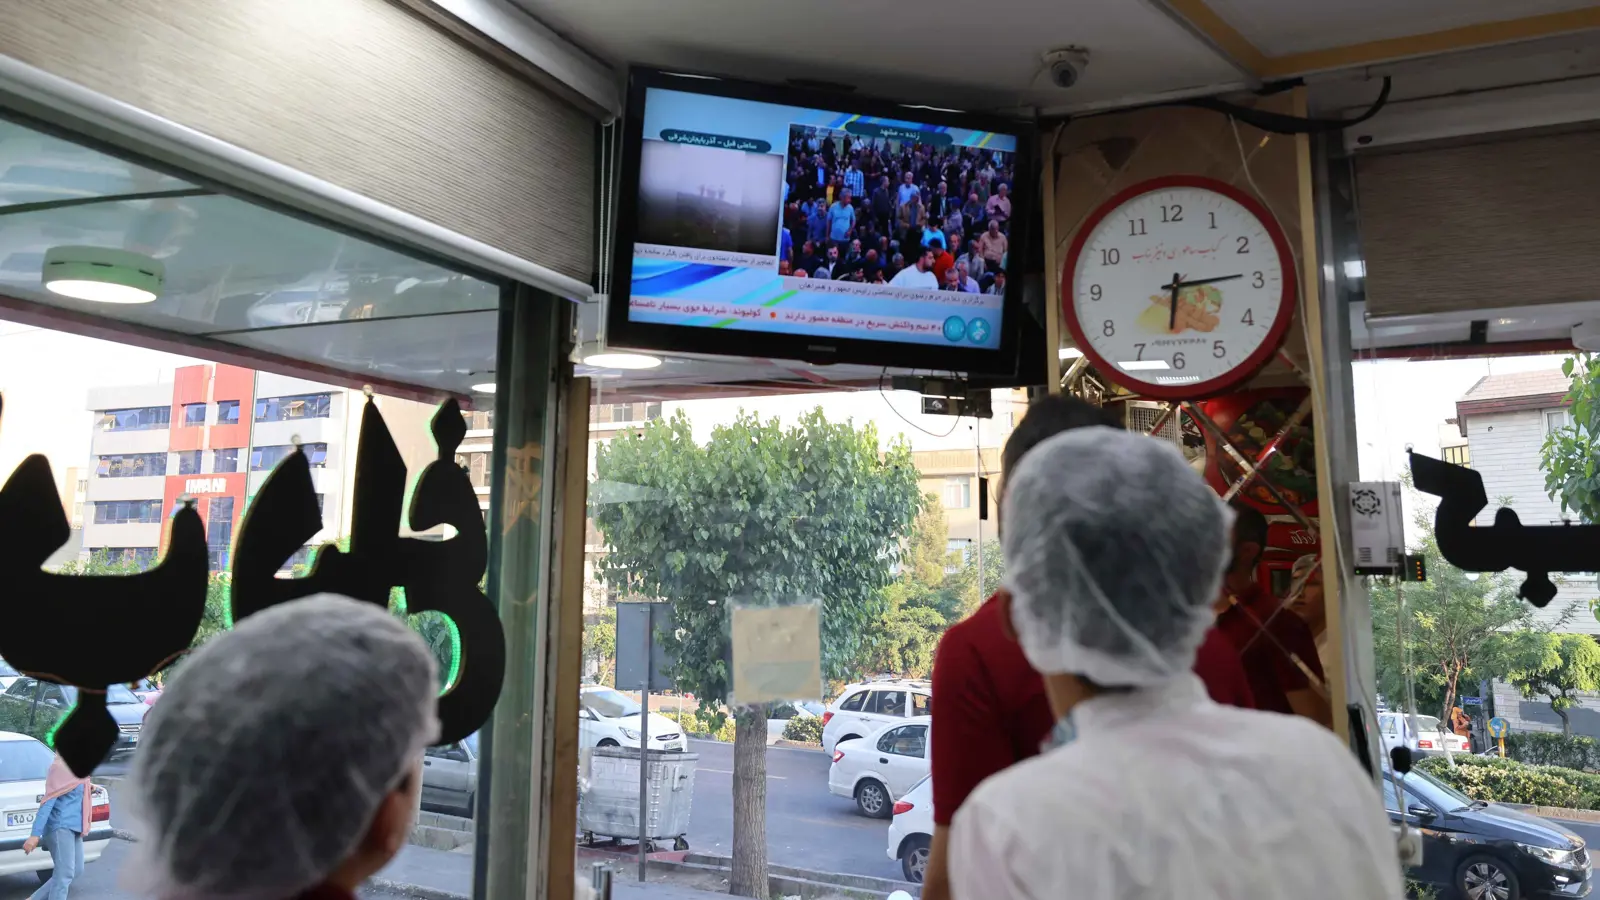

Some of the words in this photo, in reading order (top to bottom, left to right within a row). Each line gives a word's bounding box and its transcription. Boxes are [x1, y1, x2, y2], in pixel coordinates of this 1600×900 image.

[1160, 204, 1184, 223] 12
[1208, 211, 1218, 229] 1
[1128, 218, 1148, 236] 11
[1236, 236, 1250, 254] 2
[1100, 248, 1120, 266] 10
[1252, 271, 1265, 289] 3
[1090, 284, 1102, 301] 9
[1240, 308, 1254, 326] 4
[1103, 319, 1115, 337] 8
[1133, 343, 1147, 361] 7
[1212, 340, 1226, 358] 5
[1172, 352, 1185, 370] 6
